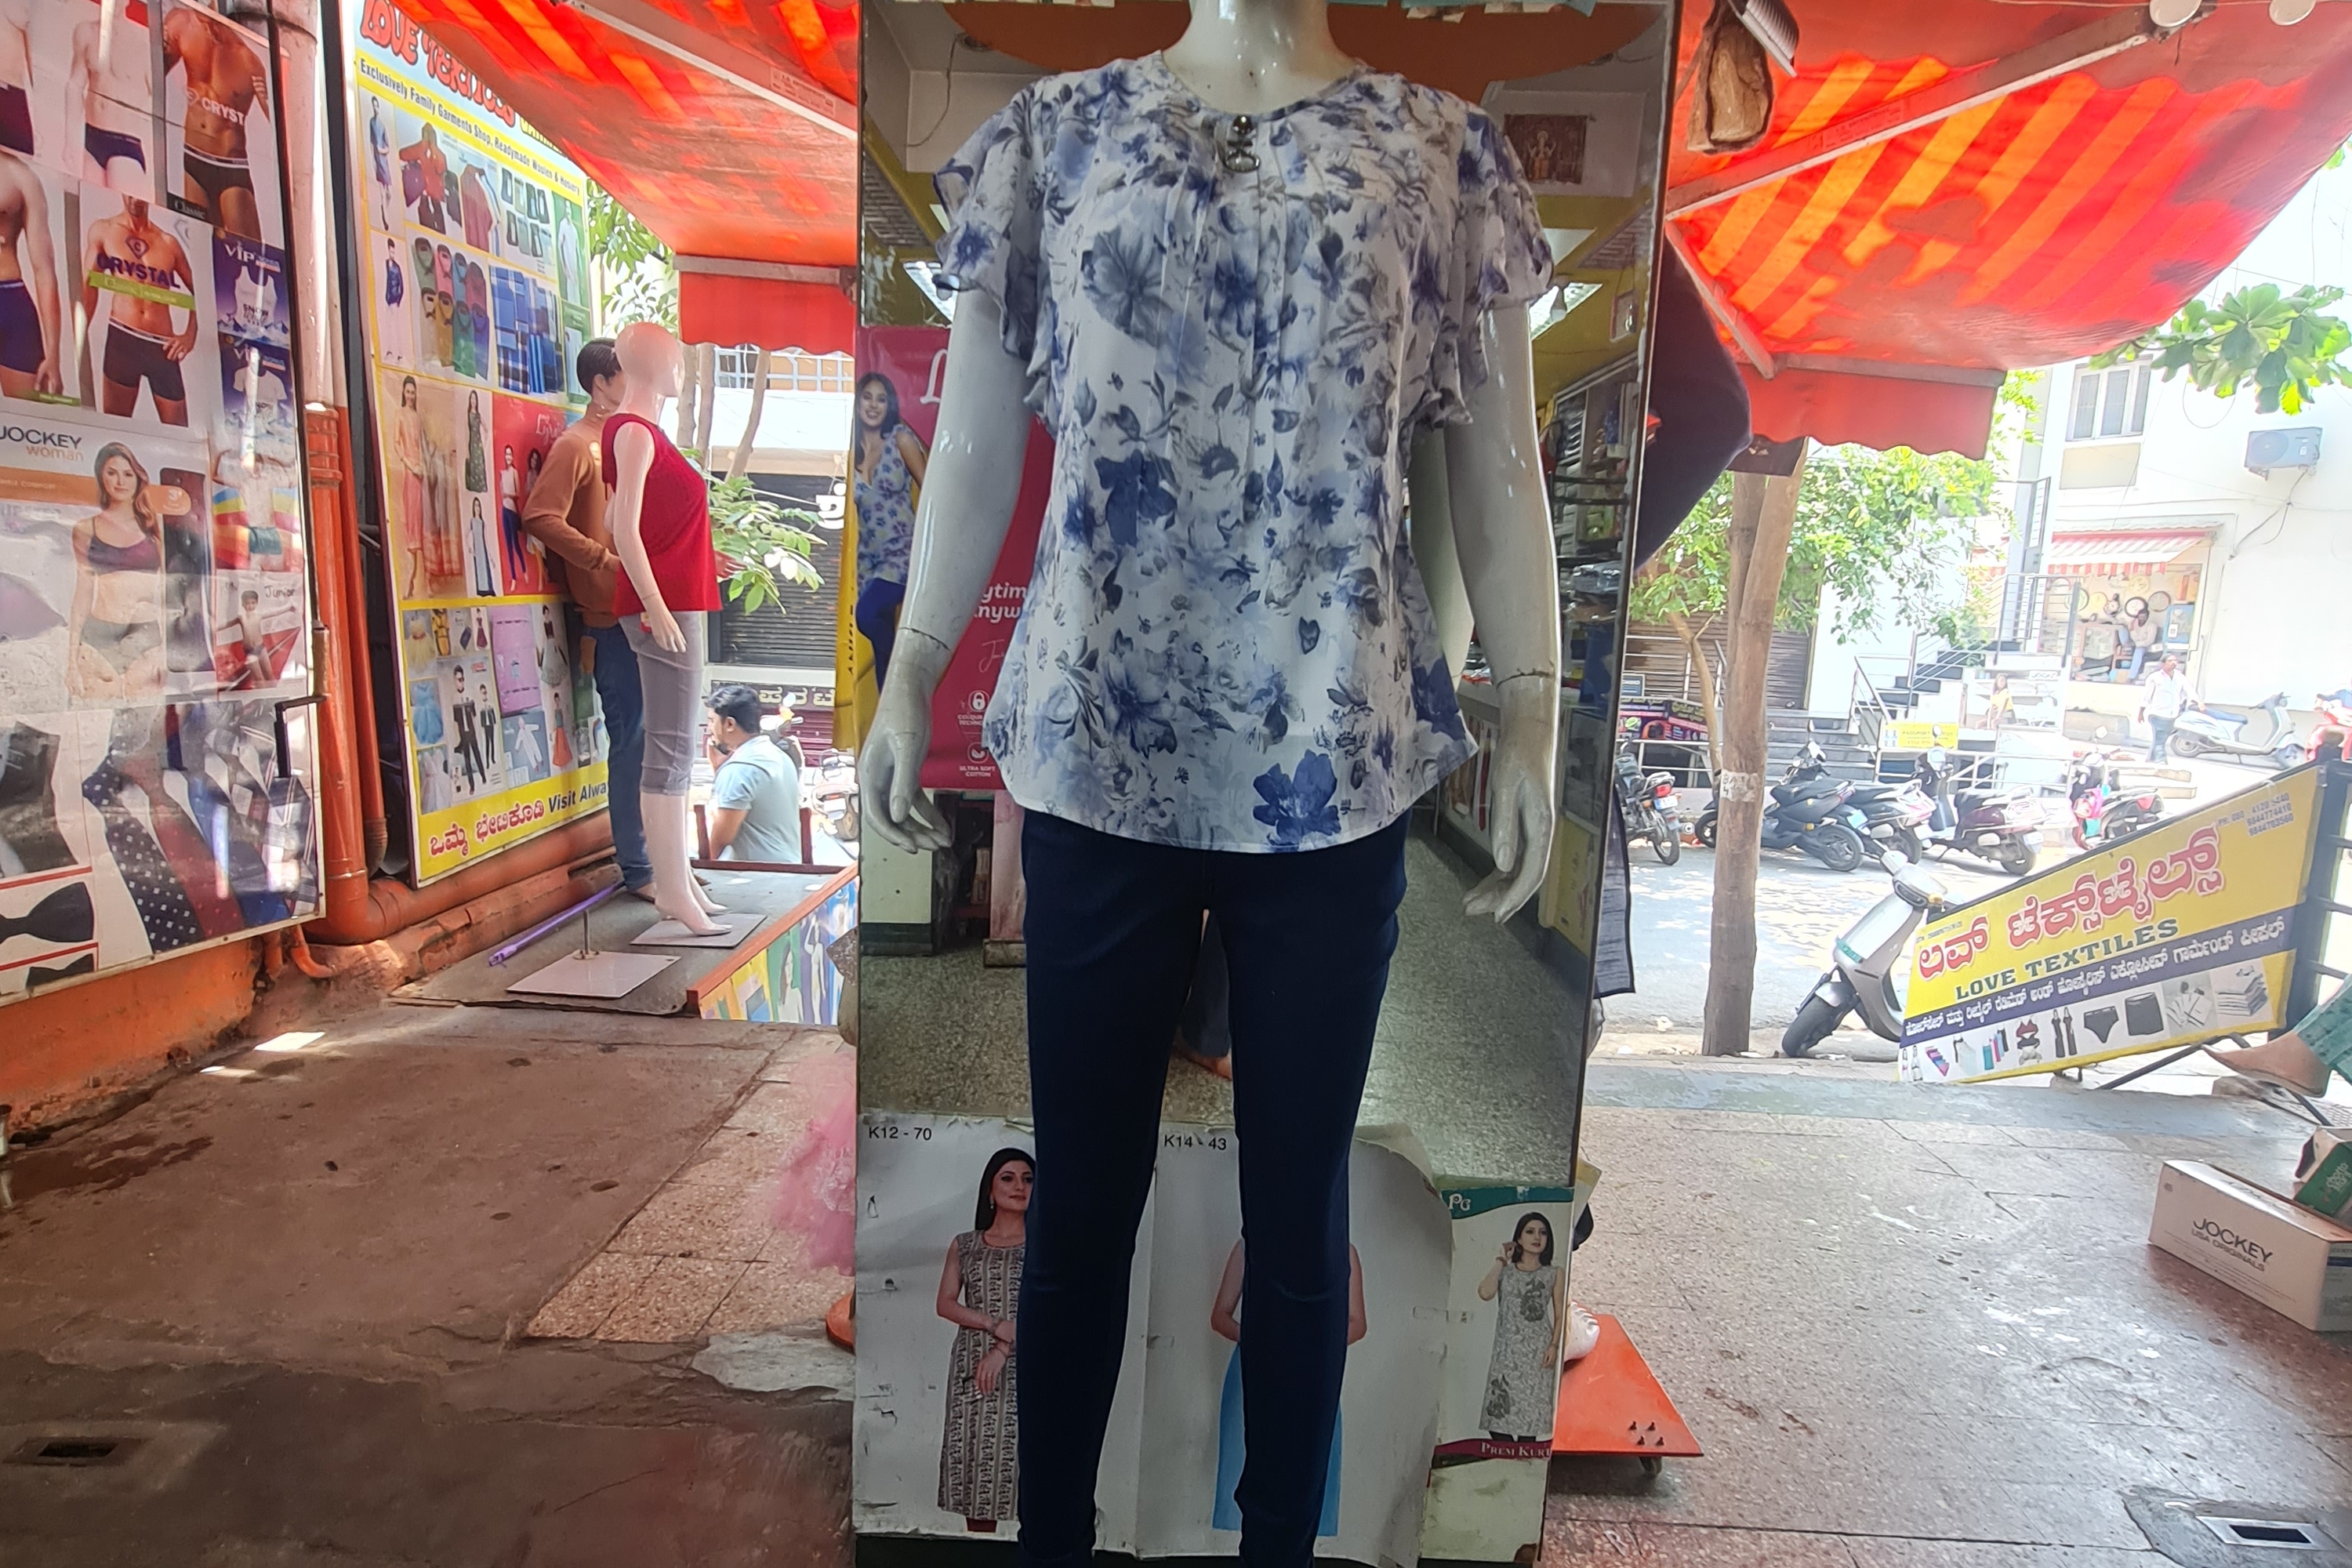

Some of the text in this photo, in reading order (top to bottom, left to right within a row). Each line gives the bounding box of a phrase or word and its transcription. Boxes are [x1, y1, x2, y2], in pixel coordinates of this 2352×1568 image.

[360, 57, 408, 100] Exclusively
[410, 86, 436, 116] Family
[437, 103, 472, 134] Garments
[494, 136, 531, 167] Readymade
[96, 252, 181, 289] CRYSTAL
[0, 425, 82, 450] JOCKEY
[26, 445, 85, 463] woman
[548, 790, 576, 813] Visit
[1956, 919, 2179, 1000] LOVE TEXTILES
[869, 1127, 898, 1139] K12
[913, 1127, 932, 1141] 70
[1164, 1134, 1193, 1149] K14
[1208, 1137, 1228, 1151] 43
[2191, 1228, 2265, 1272] USA ORIGINALS
[2193, 1218, 2274, 1263] JOCKEY
